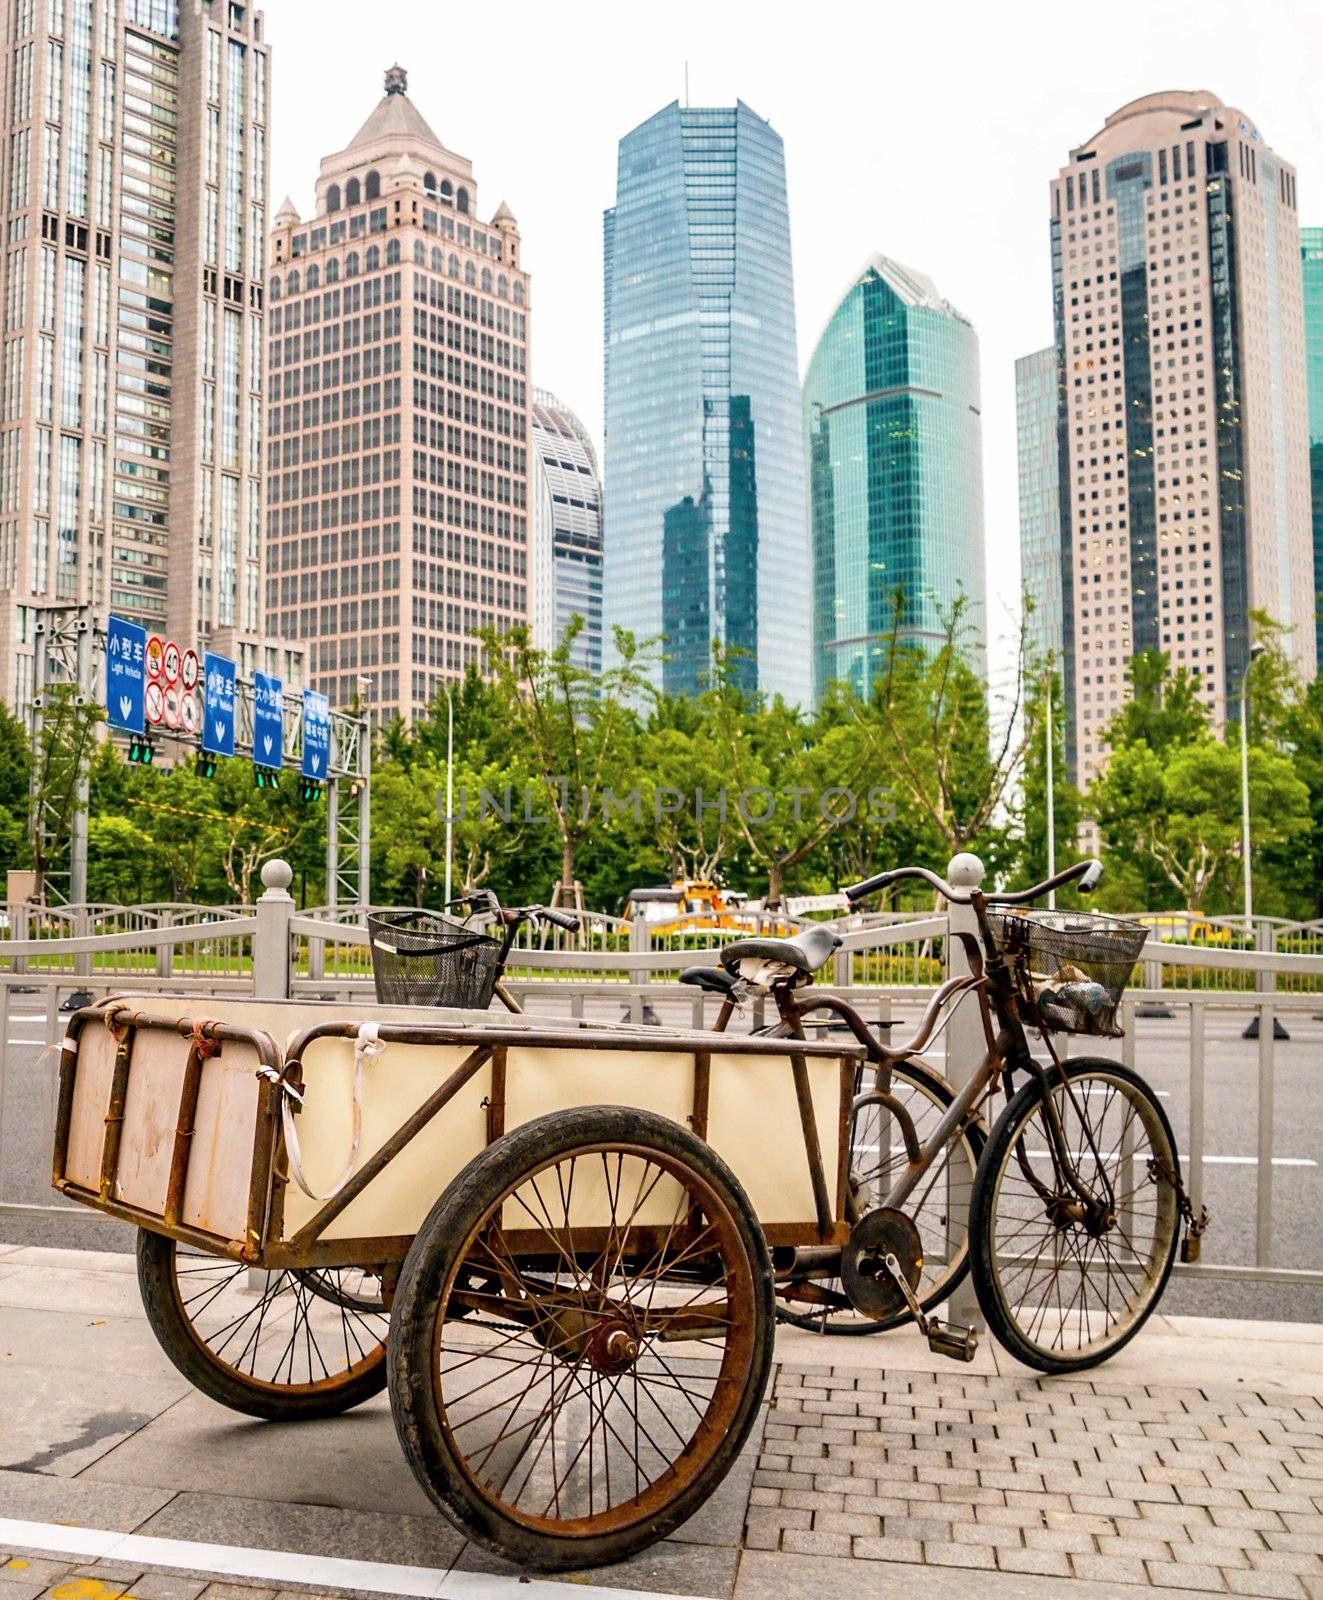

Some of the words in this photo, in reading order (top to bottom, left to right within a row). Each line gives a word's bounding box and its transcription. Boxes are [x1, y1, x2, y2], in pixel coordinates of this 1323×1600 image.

[110, 633, 143, 663] 小型车
[166, 653, 178, 675] 40
